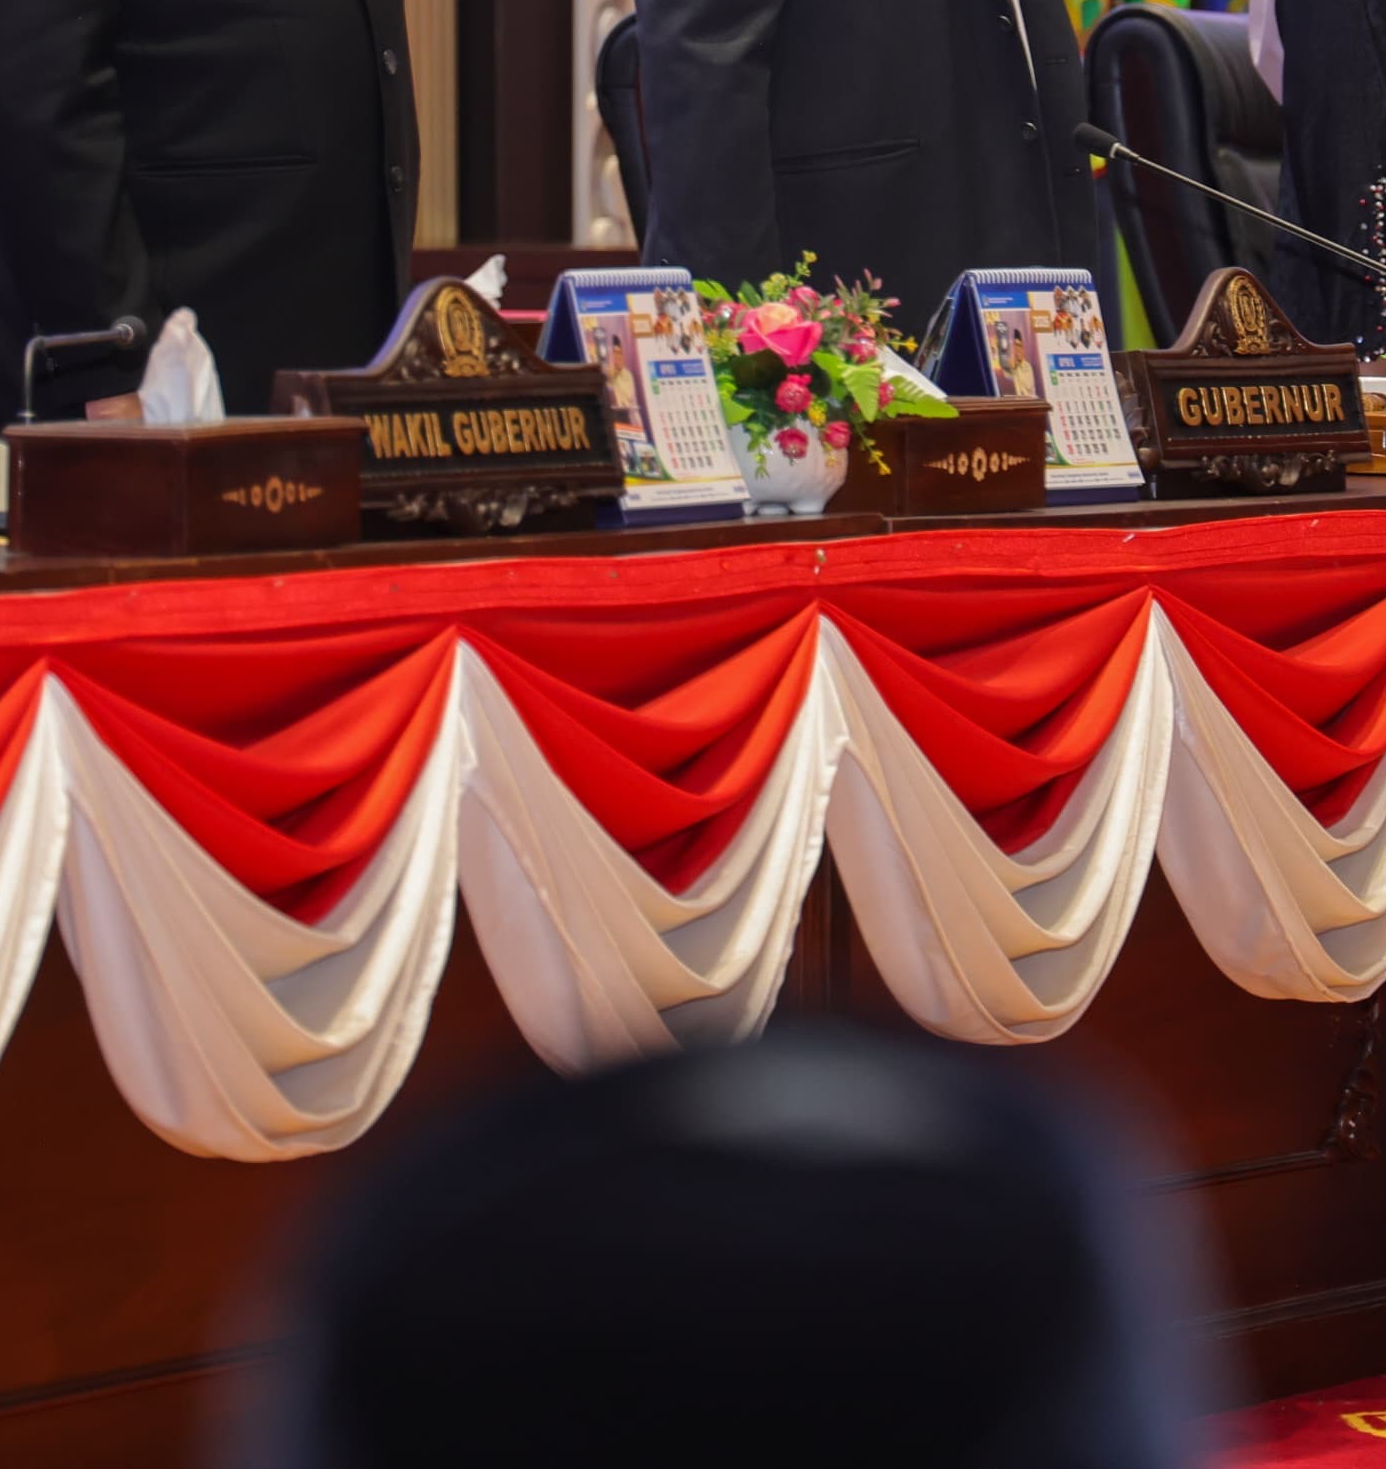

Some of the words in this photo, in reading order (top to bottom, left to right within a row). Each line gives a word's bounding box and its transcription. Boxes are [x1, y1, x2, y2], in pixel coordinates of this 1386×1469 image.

[1176, 382, 1346, 427] GUBERNUR
[363, 410, 453, 460] WAKIL
[453, 404, 592, 456] GUBERNUR
